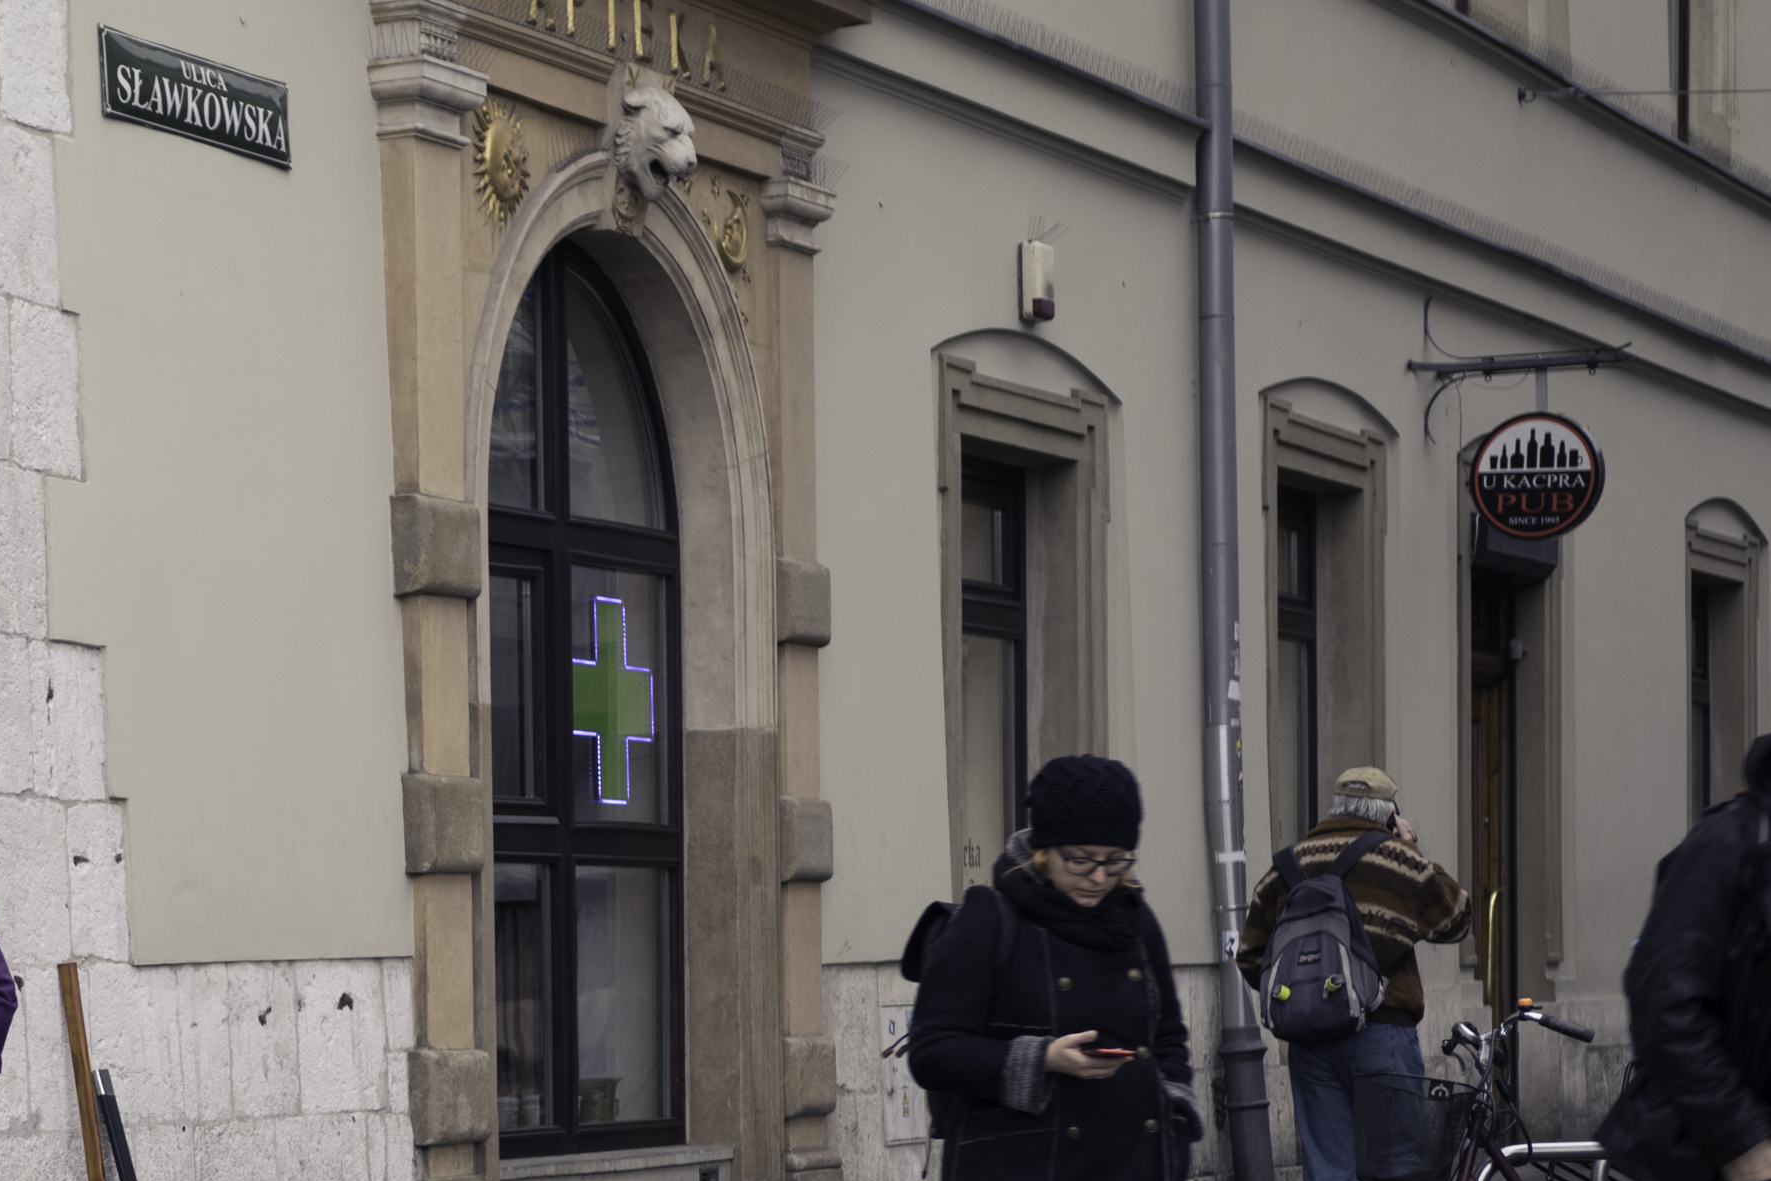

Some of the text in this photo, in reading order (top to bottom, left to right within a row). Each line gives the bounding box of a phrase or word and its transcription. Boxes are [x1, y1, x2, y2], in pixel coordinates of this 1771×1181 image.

[179, 60, 229, 92] ULICA
[116, 64, 287, 152] SŁAWKOWSKA
[1483, 473, 1586, 490] U KACPRA
[1496, 492, 1575, 514] PUB
[1508, 515, 1560, 526] SINCE 1995
